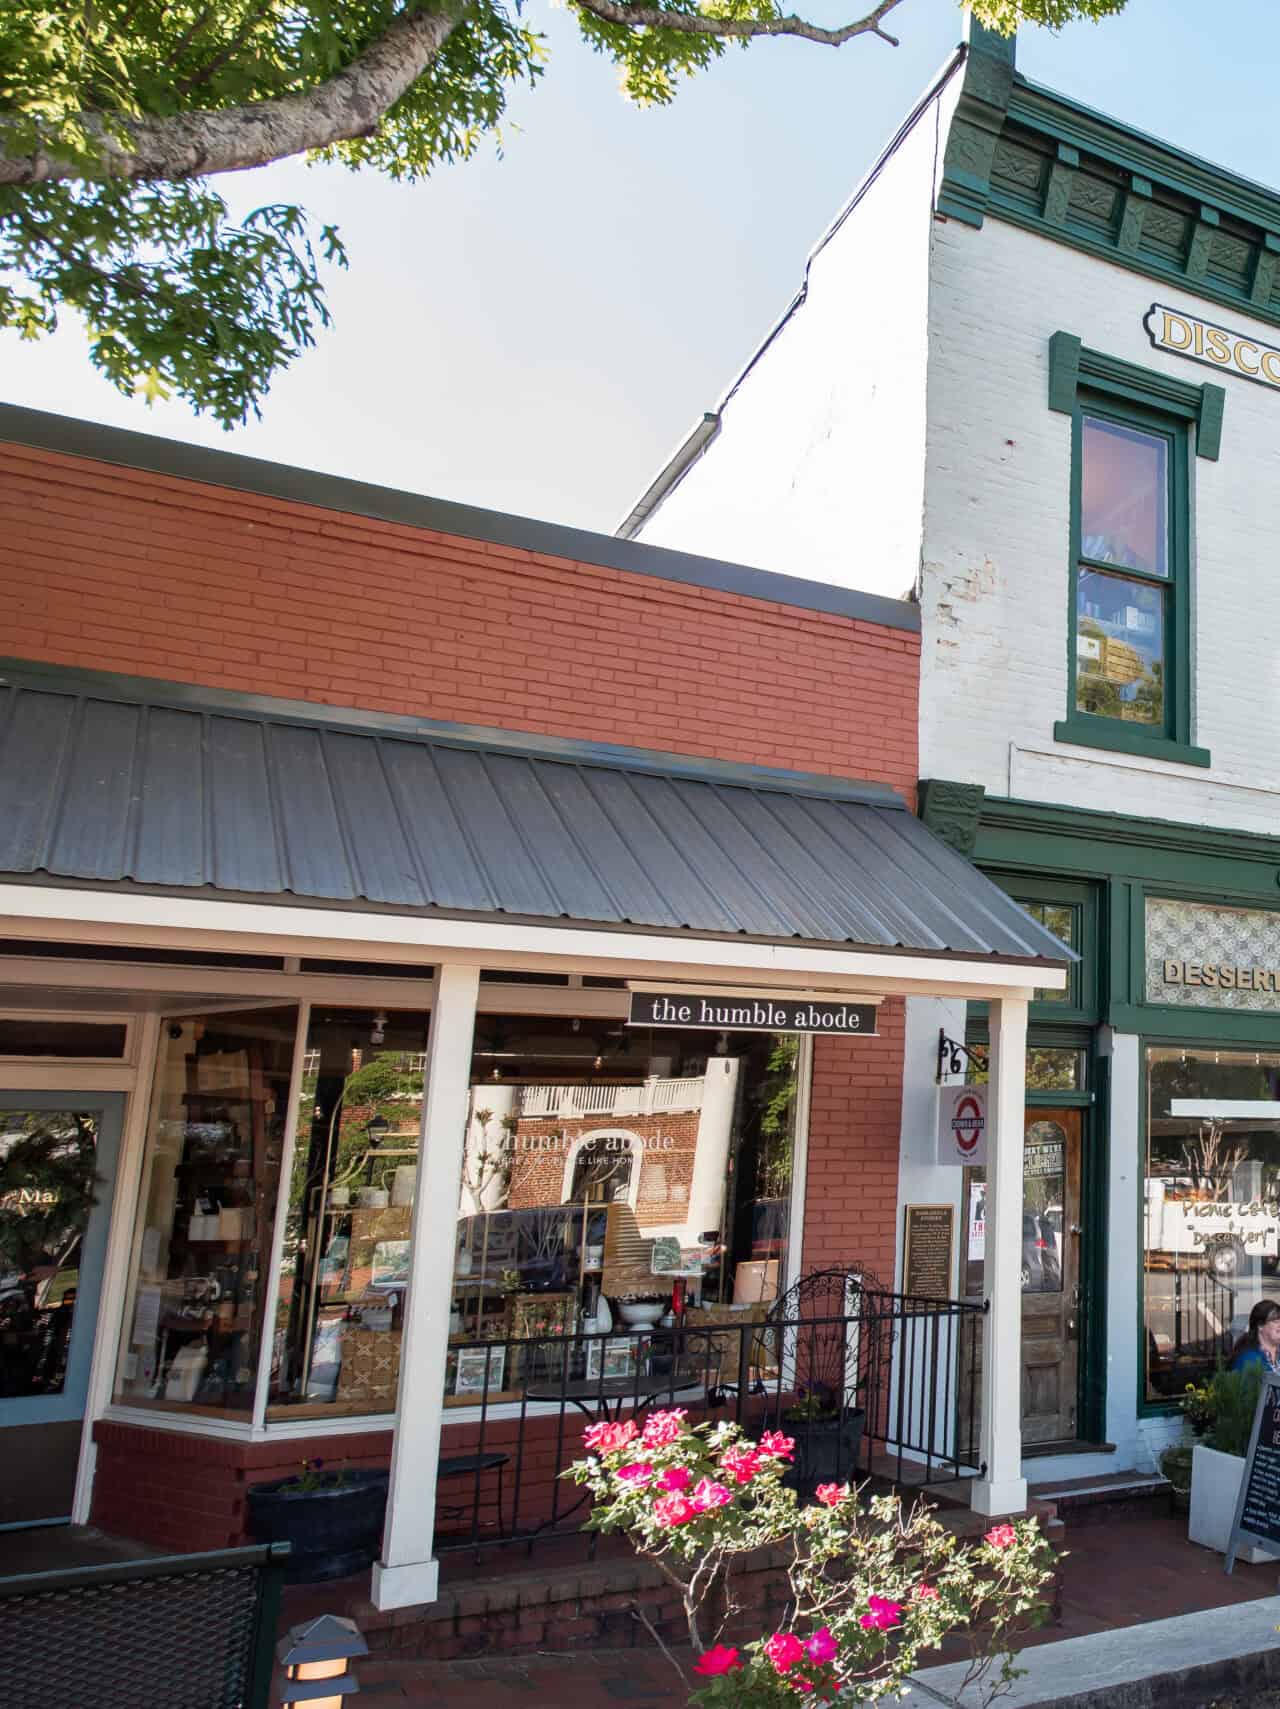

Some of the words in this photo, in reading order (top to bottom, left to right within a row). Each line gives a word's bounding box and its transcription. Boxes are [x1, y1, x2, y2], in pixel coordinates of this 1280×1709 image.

[651, 999, 692, 1022] the
[700, 1000, 787, 1026] humble
[794, 1006, 862, 1029] abode
